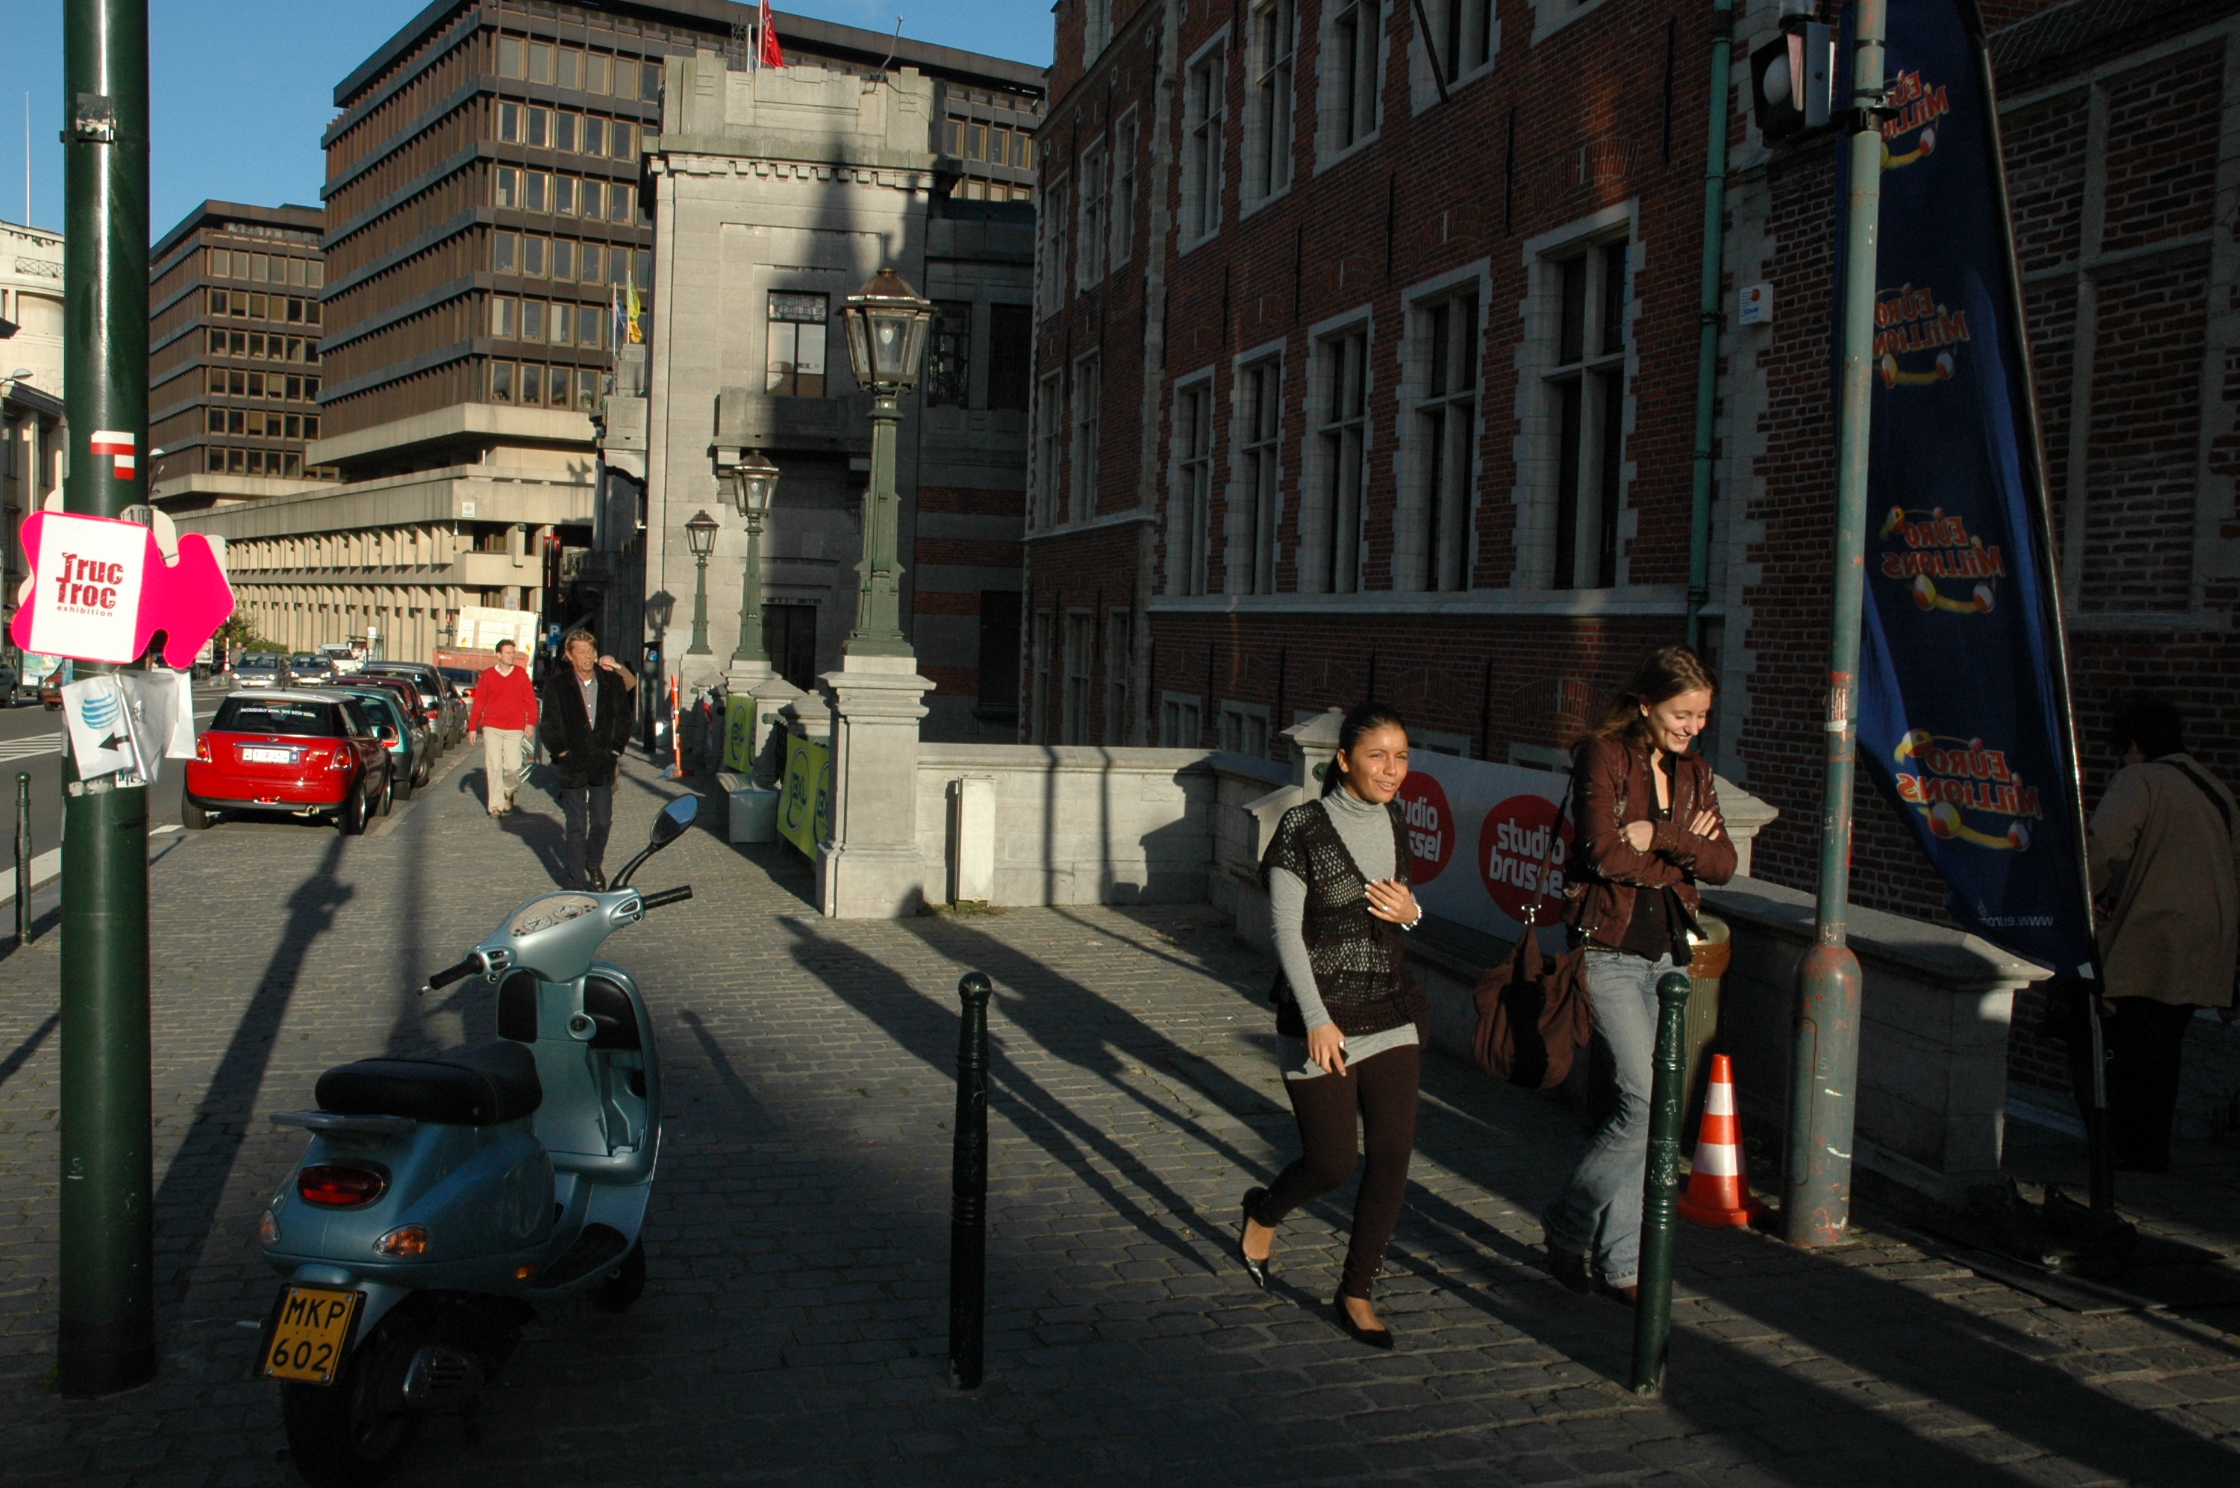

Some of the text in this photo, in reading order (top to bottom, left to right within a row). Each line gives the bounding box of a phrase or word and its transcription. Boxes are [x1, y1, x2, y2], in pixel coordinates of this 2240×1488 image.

[62, 552, 124, 585] Truc
[56, 576, 117, 609] Troc
[57, 605, 113, 617] exhibition
[550, 625, 560, 637] P
[1393, 791, 1438, 831] tudio
[1496, 817, 1565, 865] studio
[1489, 845, 1566, 900] brusse
[284, 1296, 346, 1329] MKP
[272, 1339, 333, 1372] 602
